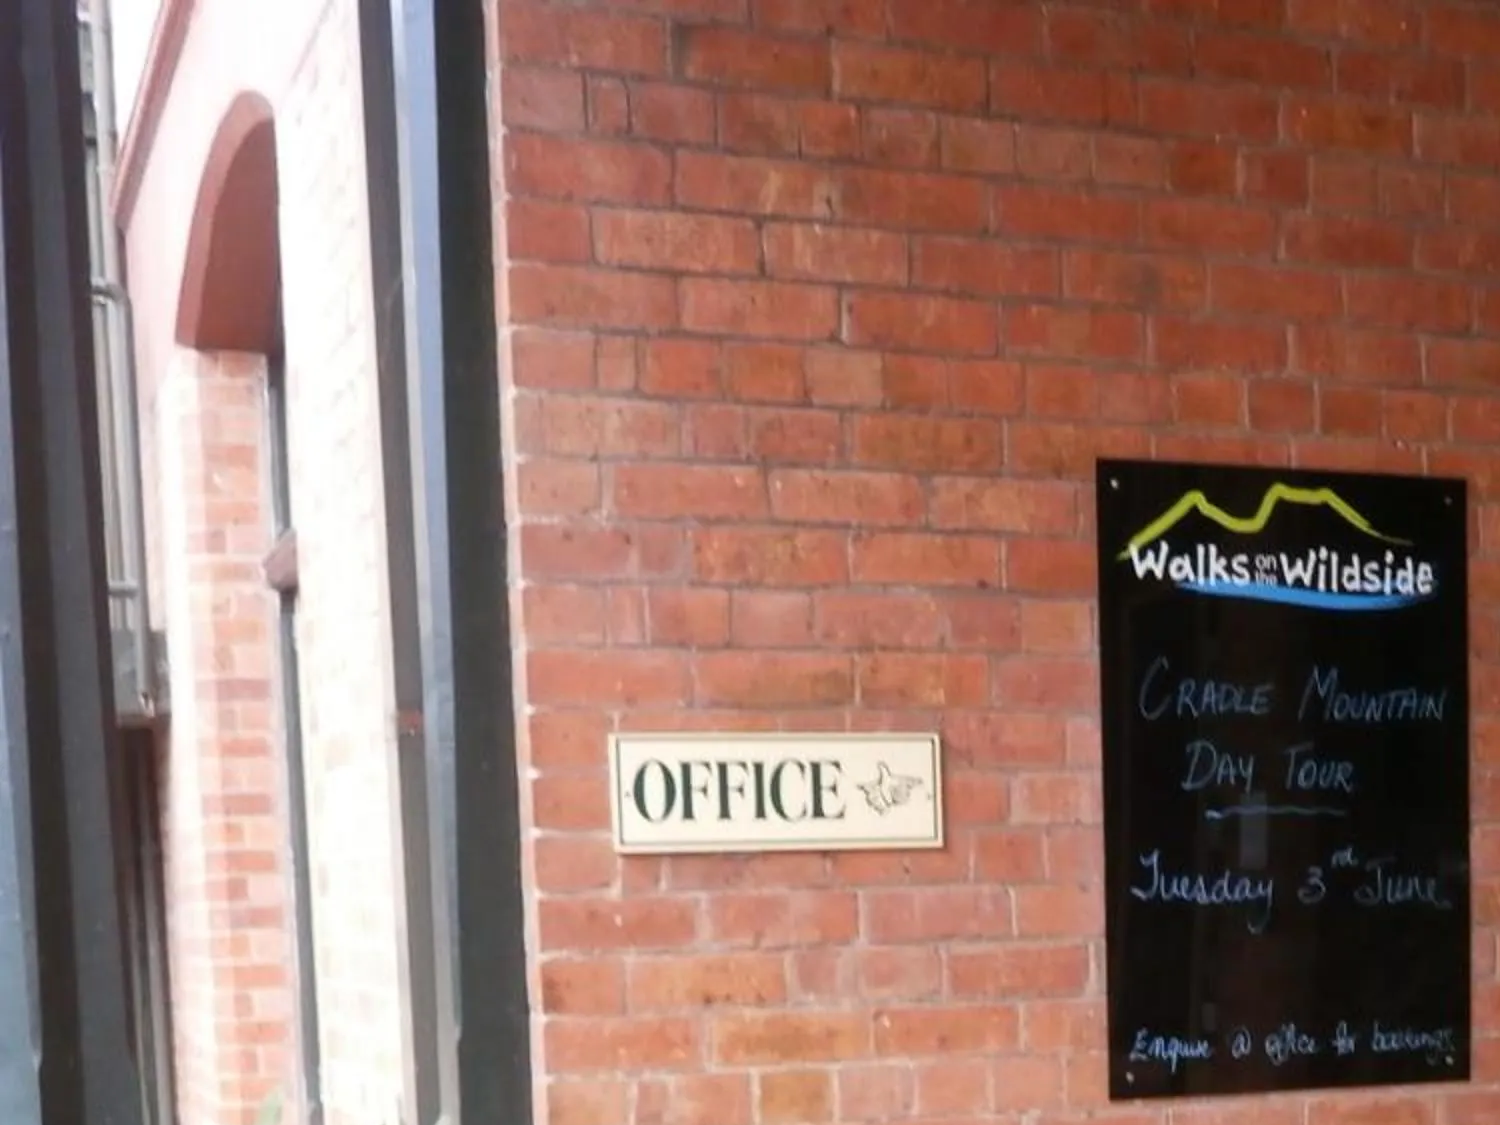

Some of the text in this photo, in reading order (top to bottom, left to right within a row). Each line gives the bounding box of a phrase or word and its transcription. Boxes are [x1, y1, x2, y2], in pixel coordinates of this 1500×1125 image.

[1128, 541, 1250, 587] Walks
[1254, 553, 1277, 570] on
[1279, 546, 1434, 597] Wildside
[1139, 655, 1448, 722] CRADLE MOUNTAIN
[632, 757, 848, 824] OFFICE
[1130, 848, 1274, 934] Tuesday
[1353, 856, 1452, 910] June
